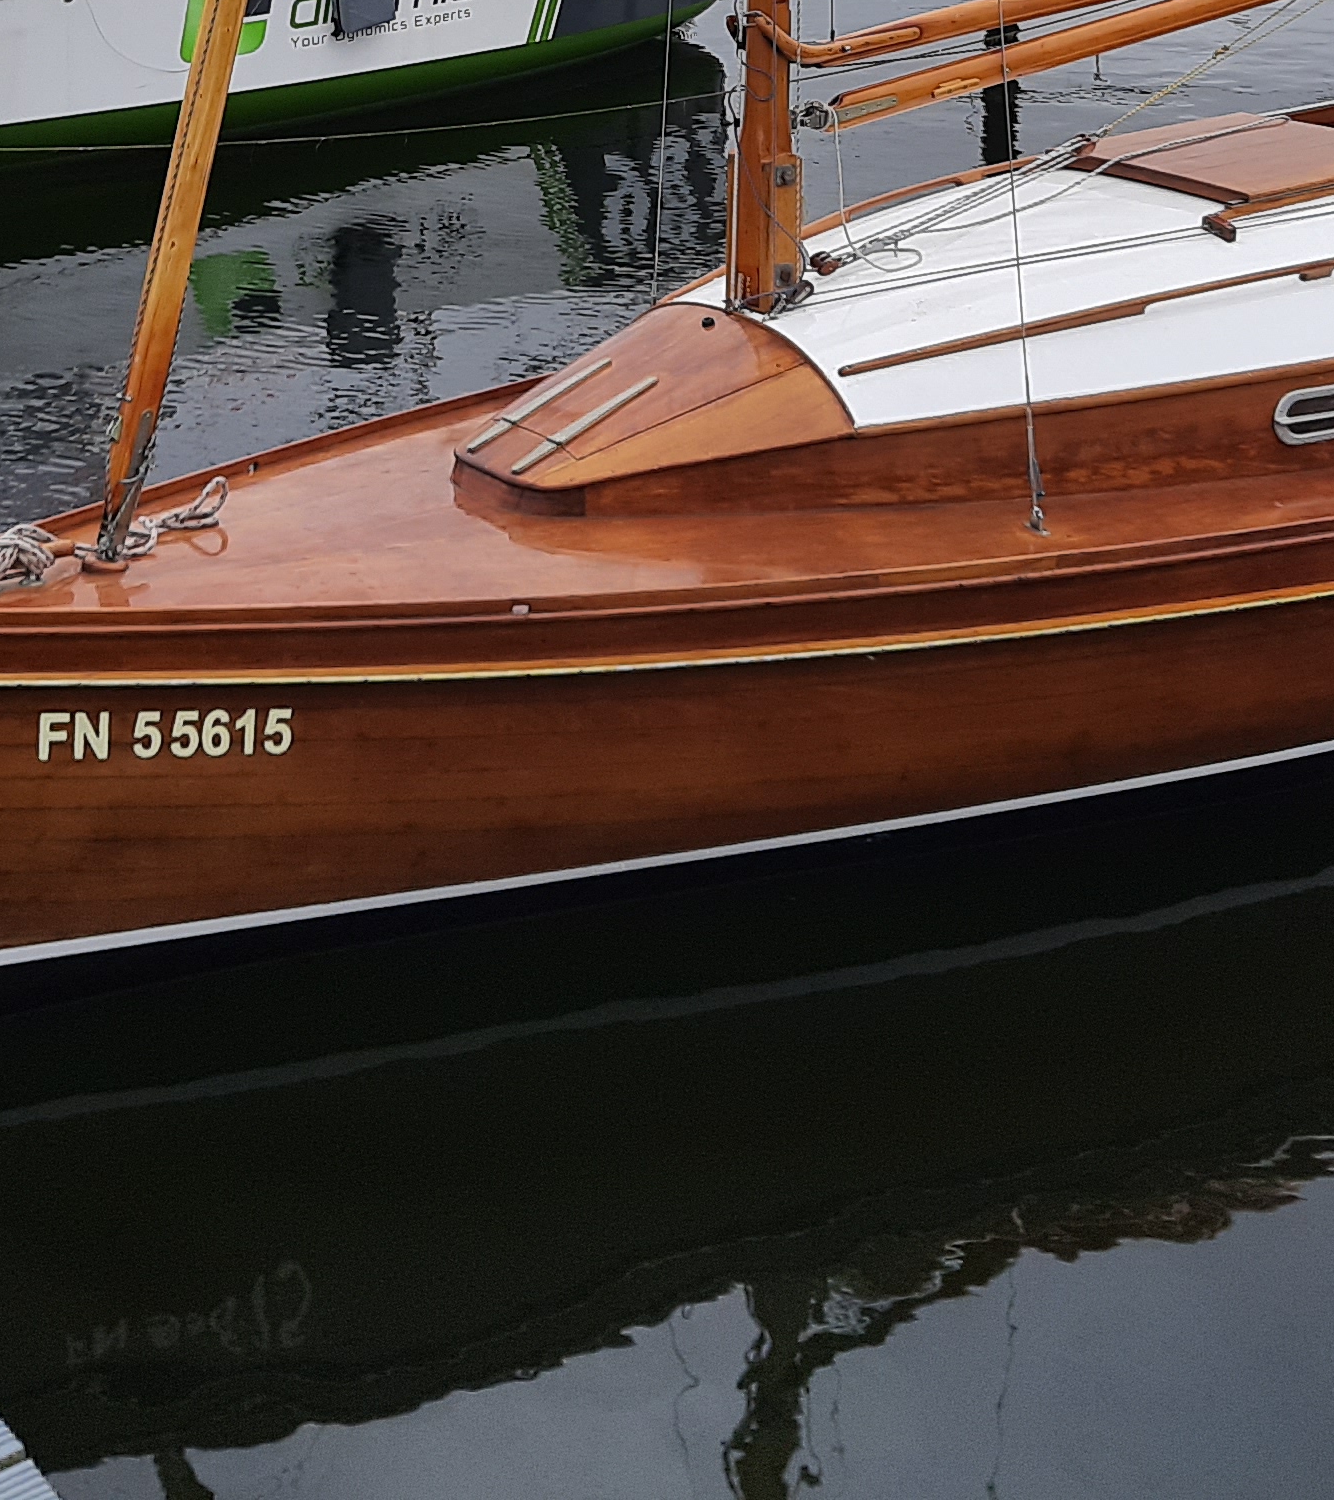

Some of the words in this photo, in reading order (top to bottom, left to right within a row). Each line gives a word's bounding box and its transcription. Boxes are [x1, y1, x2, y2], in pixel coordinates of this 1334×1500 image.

[291, 32, 328, 48] Your
[414, 8, 471, 27] Experts
[38, 710, 110, 762] FN
[132, 707, 293, 760] 55615
